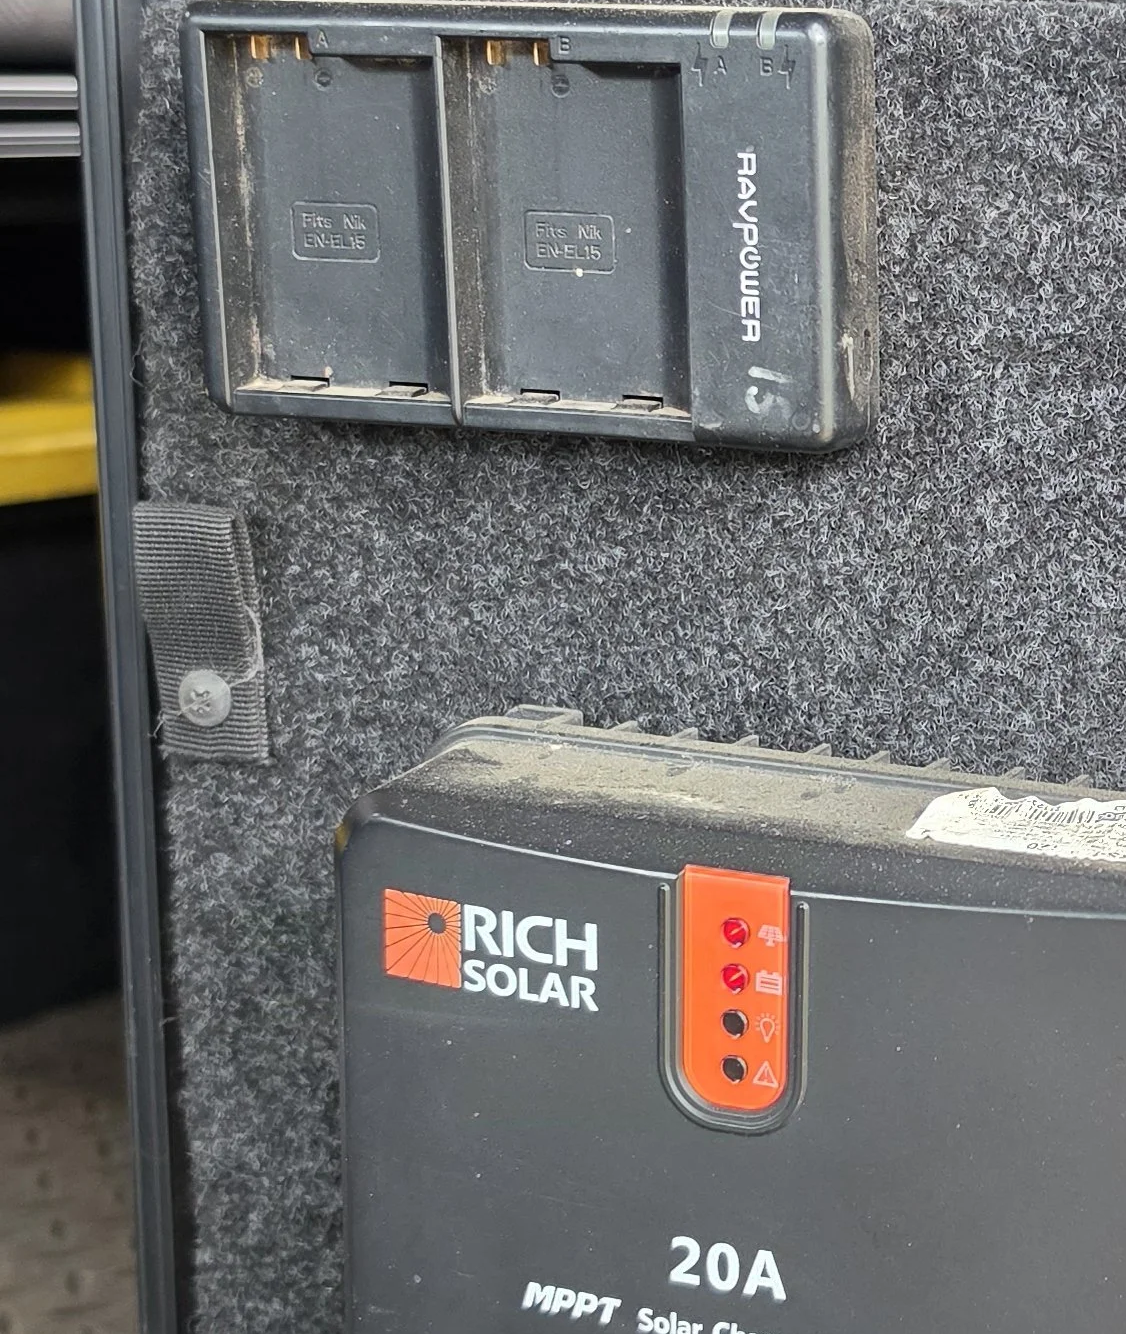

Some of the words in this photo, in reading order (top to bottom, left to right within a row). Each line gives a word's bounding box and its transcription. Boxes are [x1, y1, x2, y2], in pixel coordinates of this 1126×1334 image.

[316, 29, 330, 49] A
[559, 36, 573, 56] B
[714, 55, 728, 76] A
[759, 56, 774, 77] B
[302, 212, 333, 230] Fits
[343, 212, 368, 230] Nik
[535, 222, 567, 239] Fits
[578, 223, 603, 241] Nik
[303, 232, 366, 251] EN-EL15
[537, 243, 602, 261] EN-EL15
[732, 152, 762, 343] RAVPOWER
[463, 904, 598, 971] RICH
[463, 959, 599, 1012] SOLAR
[668, 1235, 787, 1302] 20A
[520, 1281, 622, 1326] MPPT
